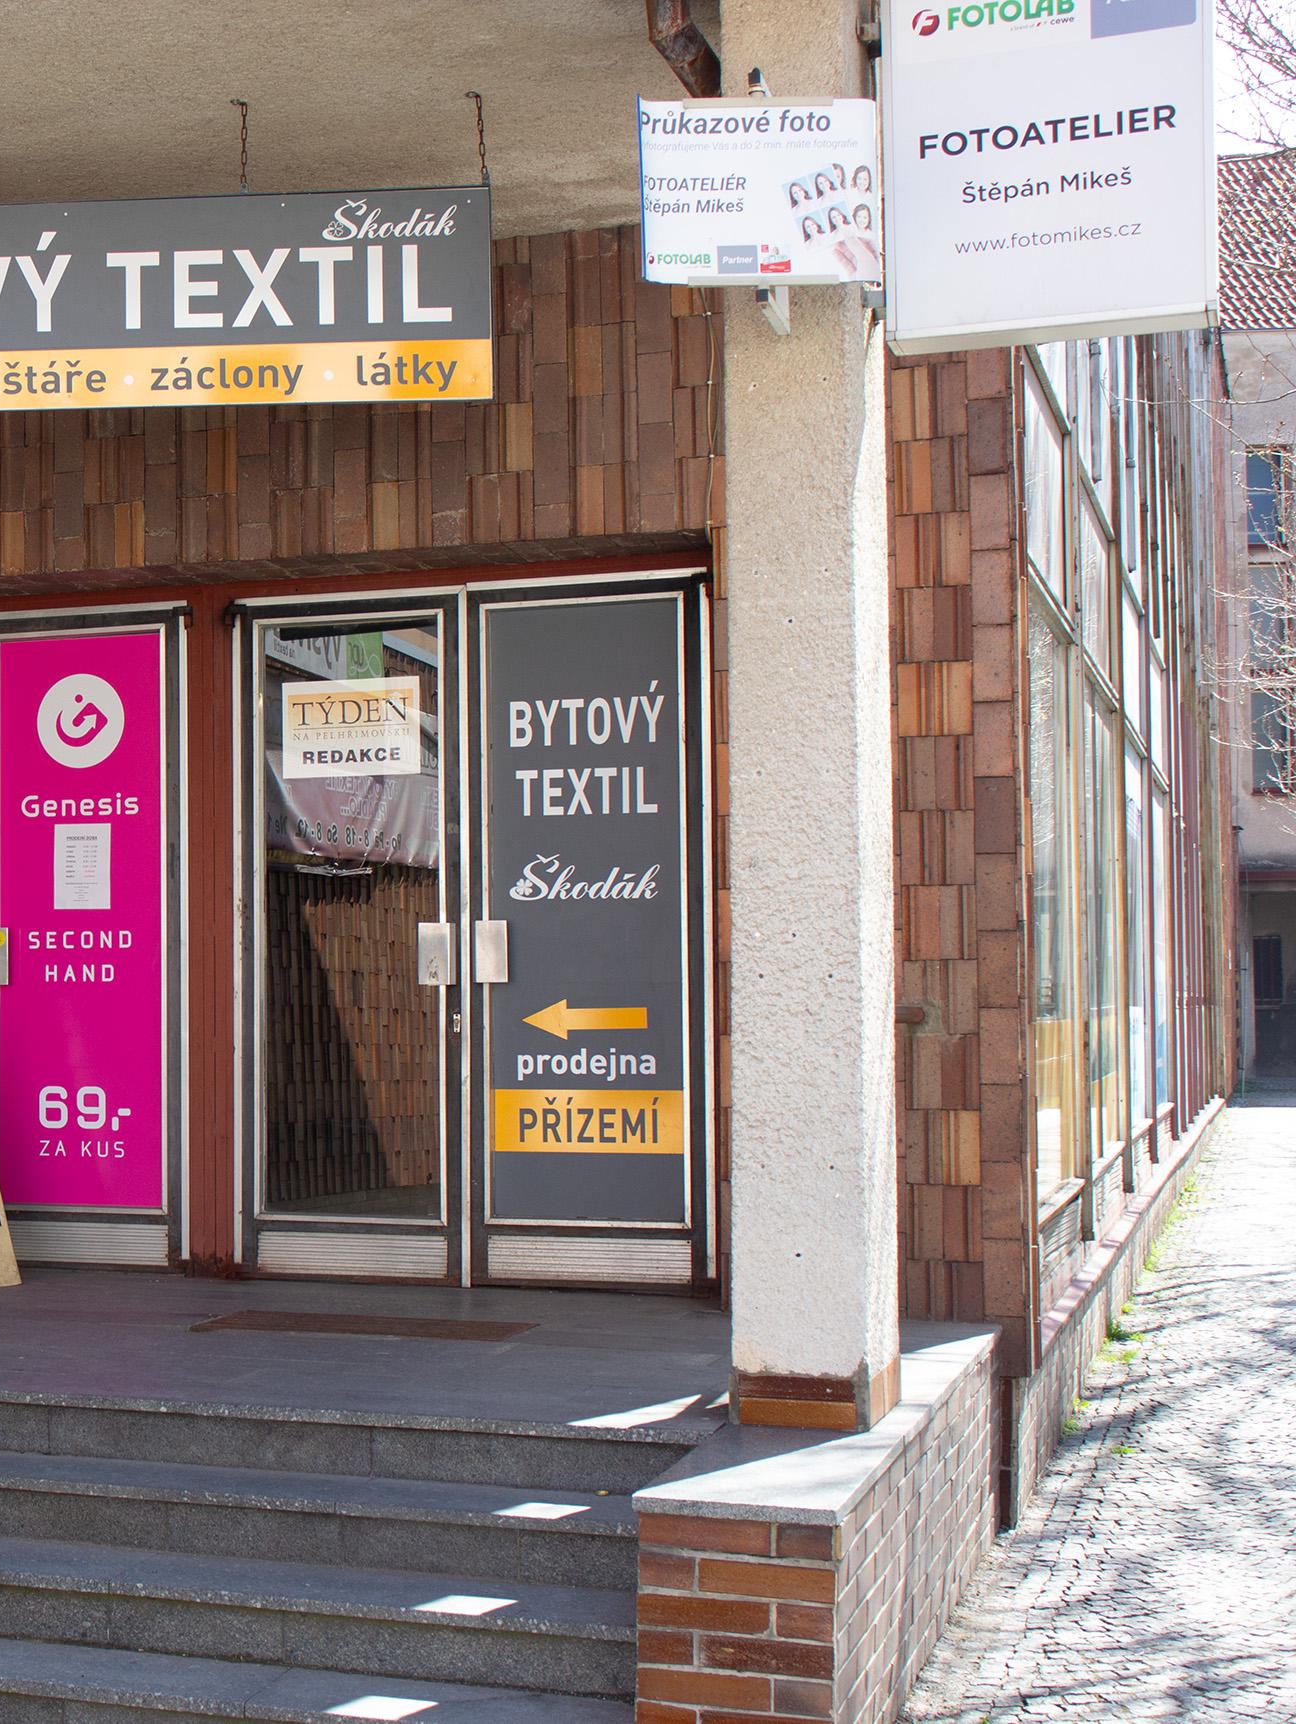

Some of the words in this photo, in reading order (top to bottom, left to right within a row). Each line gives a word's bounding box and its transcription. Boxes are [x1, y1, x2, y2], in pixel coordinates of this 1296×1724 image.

[947, 0, 1074, 31] FOTOLAB
[1050, 16, 1074, 26] cewe
[641, 110, 770, 134] Průkazové
[780, 109, 831, 132] foto
[919, 104, 1176, 159] FOTOATELIER
[962, 178, 1049, 203] Štěpán
[1060, 166, 1132, 192] Mikeš
[322, 199, 458, 241] Škodák
[696, 197, 744, 213] Mikeš
[955, 223, 1142, 254] www.fotomikes.cz
[657, 253, 711, 264] FOTOLAB
[722, 256, 753, 265] Partner
[106, 244, 452, 329] TEXTIL
[151, 357, 304, 395] záclony
[356, 352, 458, 392] látky
[292, 696, 409, 726] TÝDEN
[509, 680, 665, 748] BYTOVÝ
[293, 733, 309, 741] NA
[302, 747, 401, 765] REDAKCE
[20, 792, 139, 818] Genesis
[515, 766, 659, 817] TEXTIL
[509, 853, 661, 901] Škodák
[28, 930, 132, 950] SECOND
[45, 964, 115, 982] HAND
[517, 1048, 657, 1082] prodejna
[39, 1085, 132, 1132] 69,-
[519, 1096, 660, 1144] PŘÍZEMÍ
[39, 1140, 66, 1157] ZA
[81, 1140, 125, 1158] KUS
